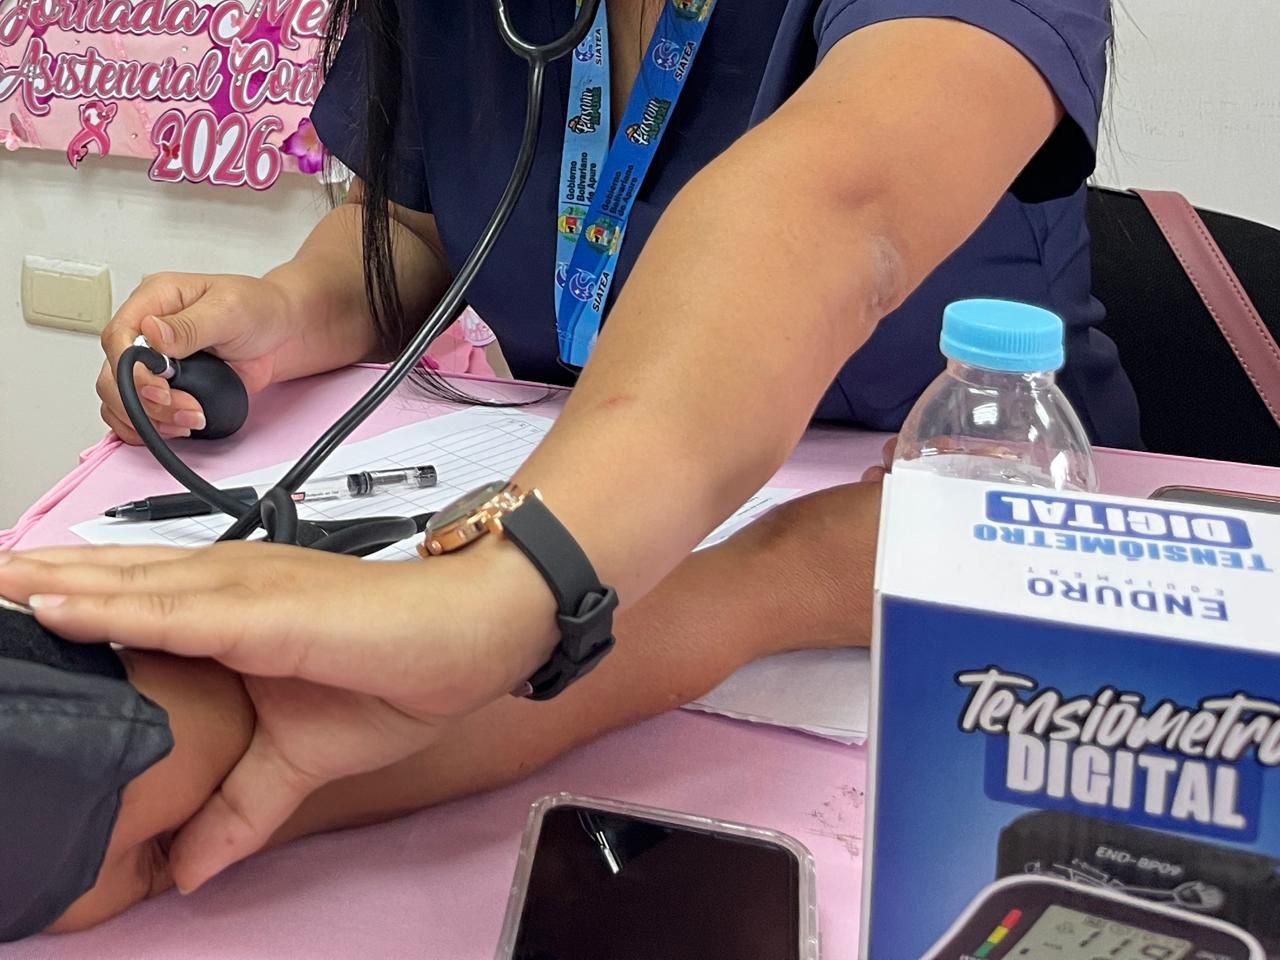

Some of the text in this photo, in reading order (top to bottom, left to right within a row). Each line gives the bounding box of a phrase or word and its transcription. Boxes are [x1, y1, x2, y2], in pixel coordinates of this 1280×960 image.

[674, 40, 696, 81] SIATEA
[149, 108, 284, 191] 2026
[566, 160, 577, 201] Gobierno
[576, 151, 588, 202] Bolivariano
[587, 162, 597, 190] Apure
[601, 171, 622, 211] Gobierno
[609, 164, 634, 215] Bolivariano
[592, 271, 610, 313] SIATEA
[1000, 495, 1233, 544] DIGITAL
[972, 523, 1274, 573] TENSIÓMETRO
[1026, 577, 1229, 622] ENDURO
[1005, 732, 1247, 829] DIGITAL
[1094, 845, 1185, 878] END-BP09
